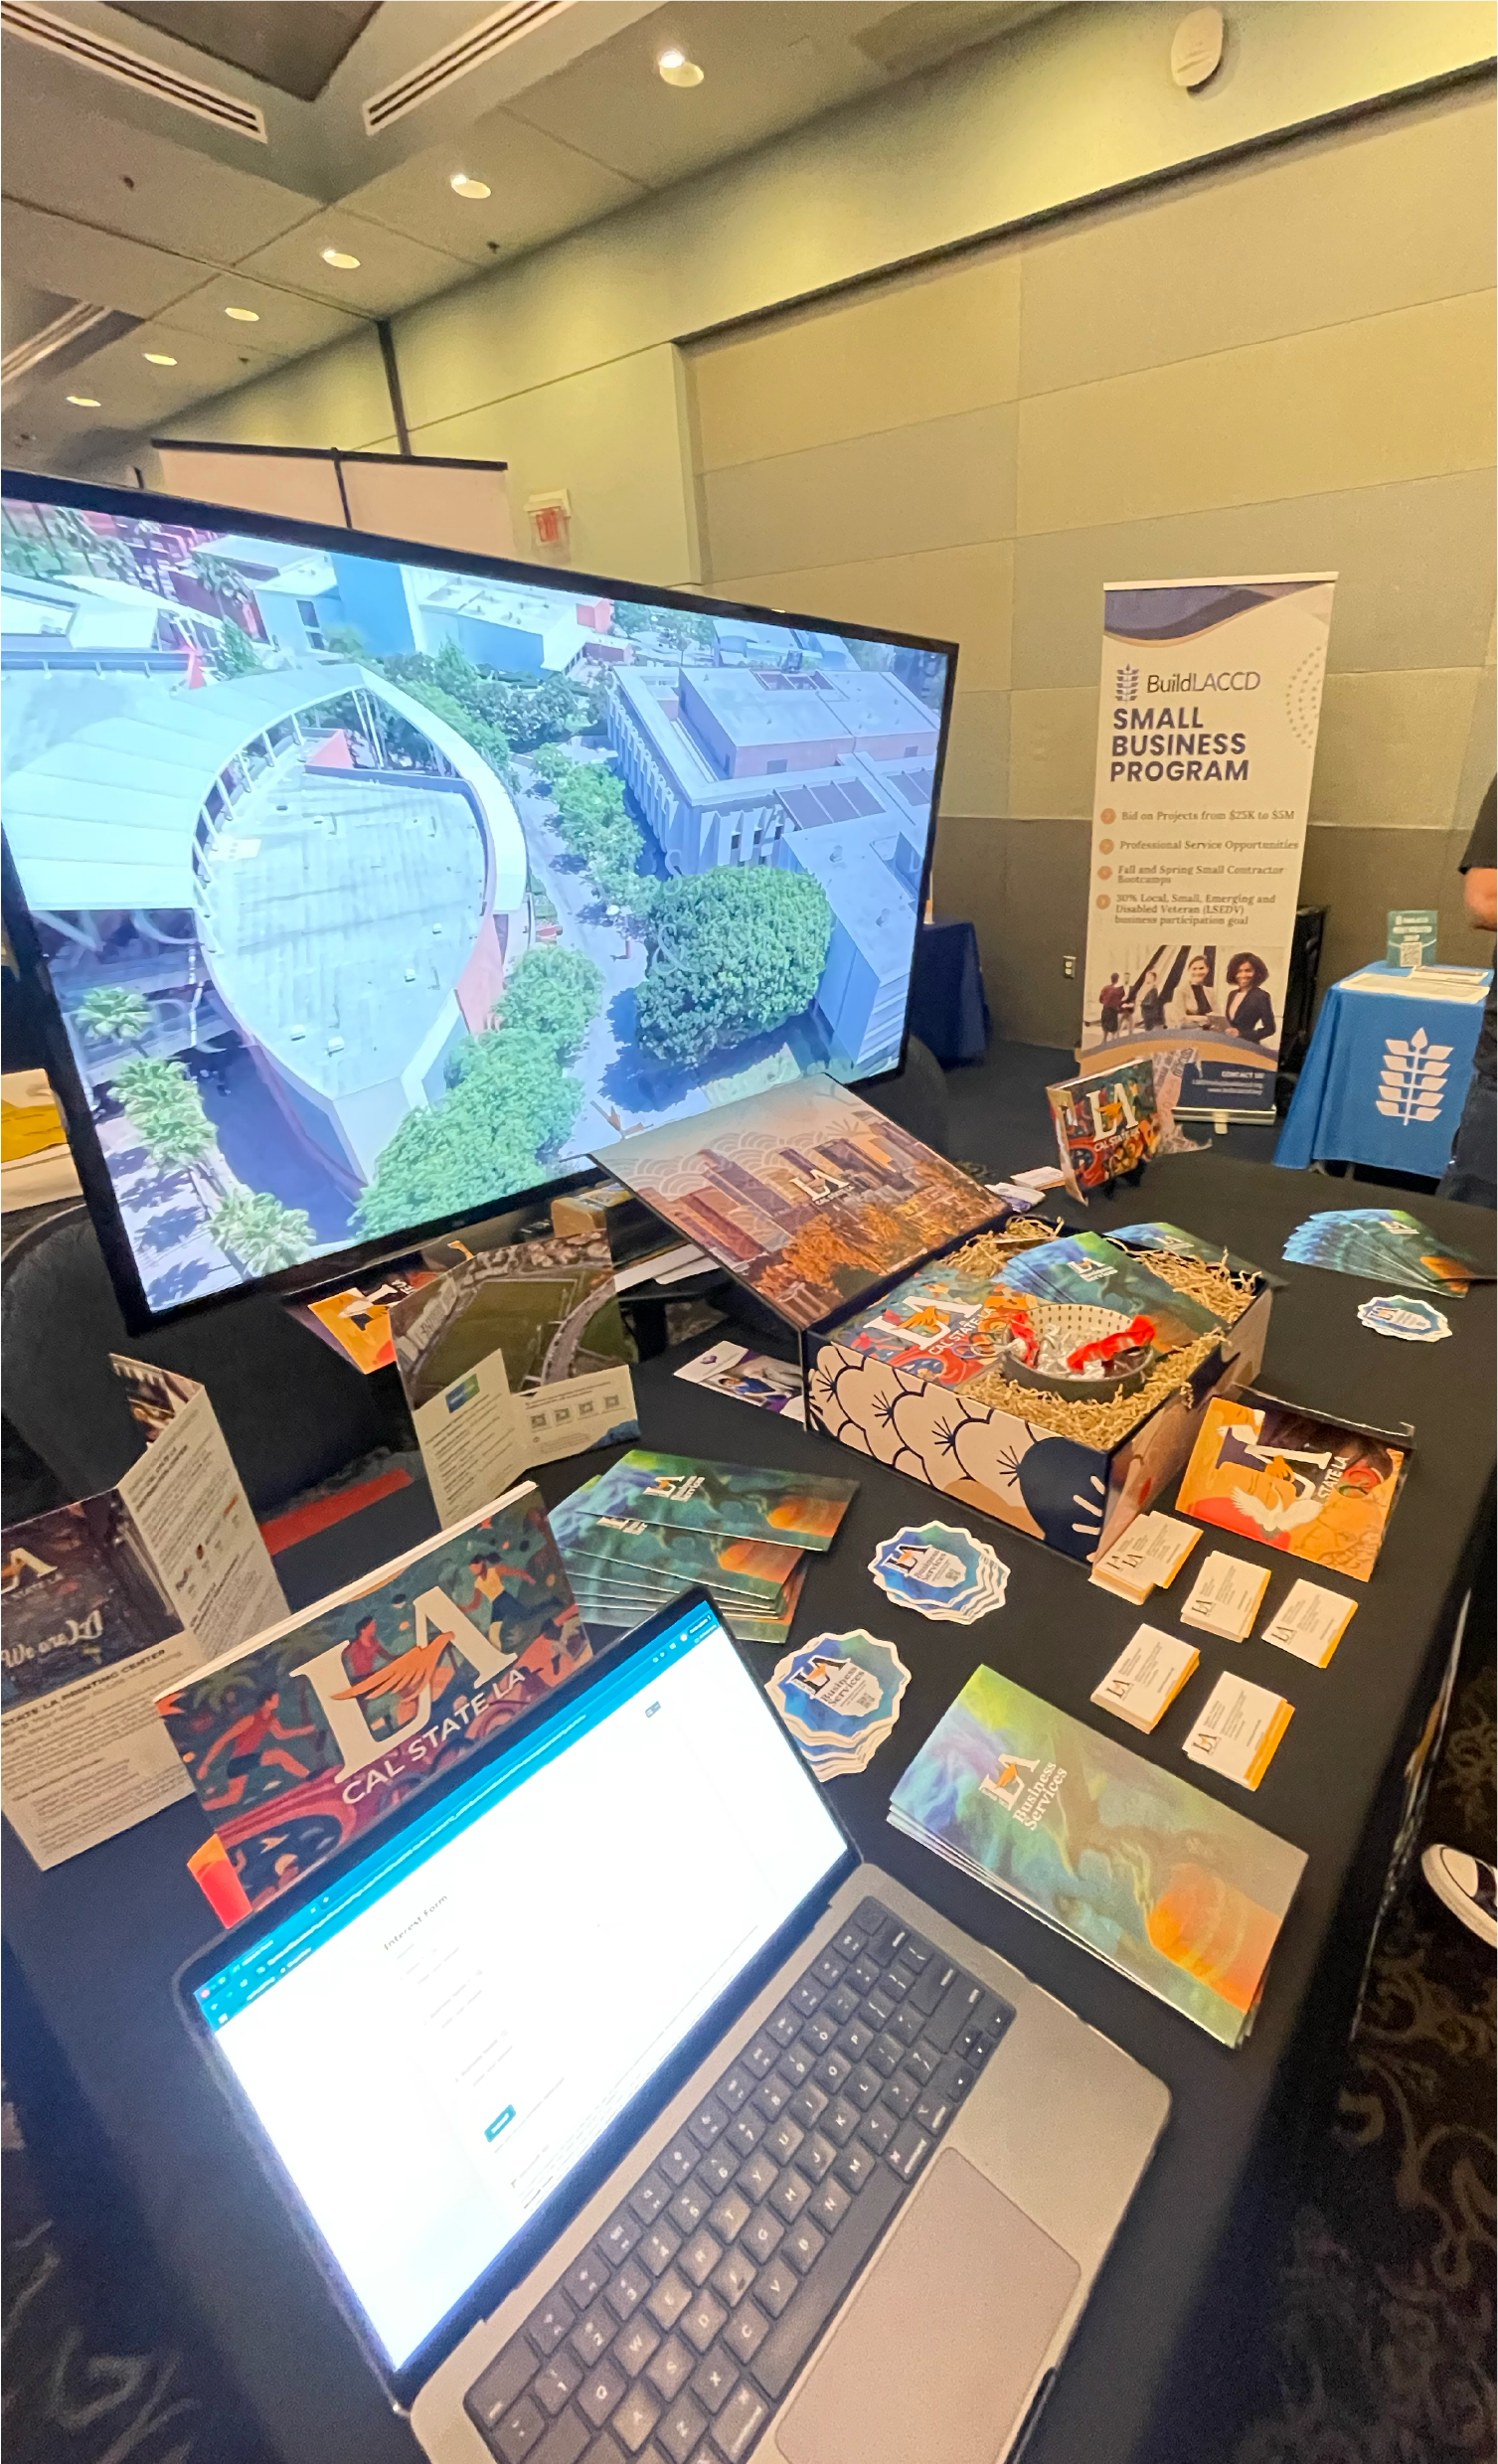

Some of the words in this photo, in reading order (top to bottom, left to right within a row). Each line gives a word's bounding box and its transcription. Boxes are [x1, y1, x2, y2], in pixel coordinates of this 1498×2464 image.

[1146, 671, 1260, 693] BuildLACCD
[1113, 707, 1204, 730] SMALL
[1111, 733, 1247, 757] BUSINESS
[1110, 759, 1249, 782] PROGRAM
[1121, 811, 1138, 820] Bid
[1157, 811, 1198, 823] Projects
[1201, 811, 1226, 820] from
[1230, 810, 1255, 820] $25K
[1119, 840, 1182, 850] Professional
[1184, 840, 1223, 849] Service
[1225, 839, 1298, 852] Opportunities
[1117, 875, 1171, 886] Bootcamps
[1118, 865, 1135, 874] Fall
[1138, 865, 1157, 874] and
[1159, 865, 1194, 876] Spring
[1196, 865, 1225, 874] Small
[1227, 865, 1284, 875] Contractor
[1115, 904, 1158, 913] Disabled
[1161, 904, 1200, 913] Veteran
[1206, 894, 1255, 905] Emerging
[1256, 895, 1275, 903] and
[1160, 915, 1225, 926] participation
[1228, 915, 1248, 927] goal
[863, 1296, 983, 1351] LA
[928, 1340, 954, 1355] CAL
[949, 1317, 982, 1342] STATE
[979, 1307, 997, 1319] LA
[1317, 1468, 1344, 1499] STATE
[1331, 1455, 1351, 1471] LA
[43, 1699, 60, 1710] LA
[62, 1671, 119, 1701] PRINTING
[121, 1649, 166, 1674] CENTER
[290, 1585, 518, 1784] LA
[820, 1666, 858, 1702] Business
[826, 1671, 865, 1708] Services
[342, 1761, 405, 1805] CAL
[408, 1695, 489, 1761] STATE
[491, 1668, 526, 1701] LA
[978, 1753, 1041, 1811] LA
[1012, 1762, 1057, 1824] Business
[1024, 1767, 1068, 1831] Services
[384, 1916, 422, 1951] Interest
[423, 1895, 448, 1916] Form
